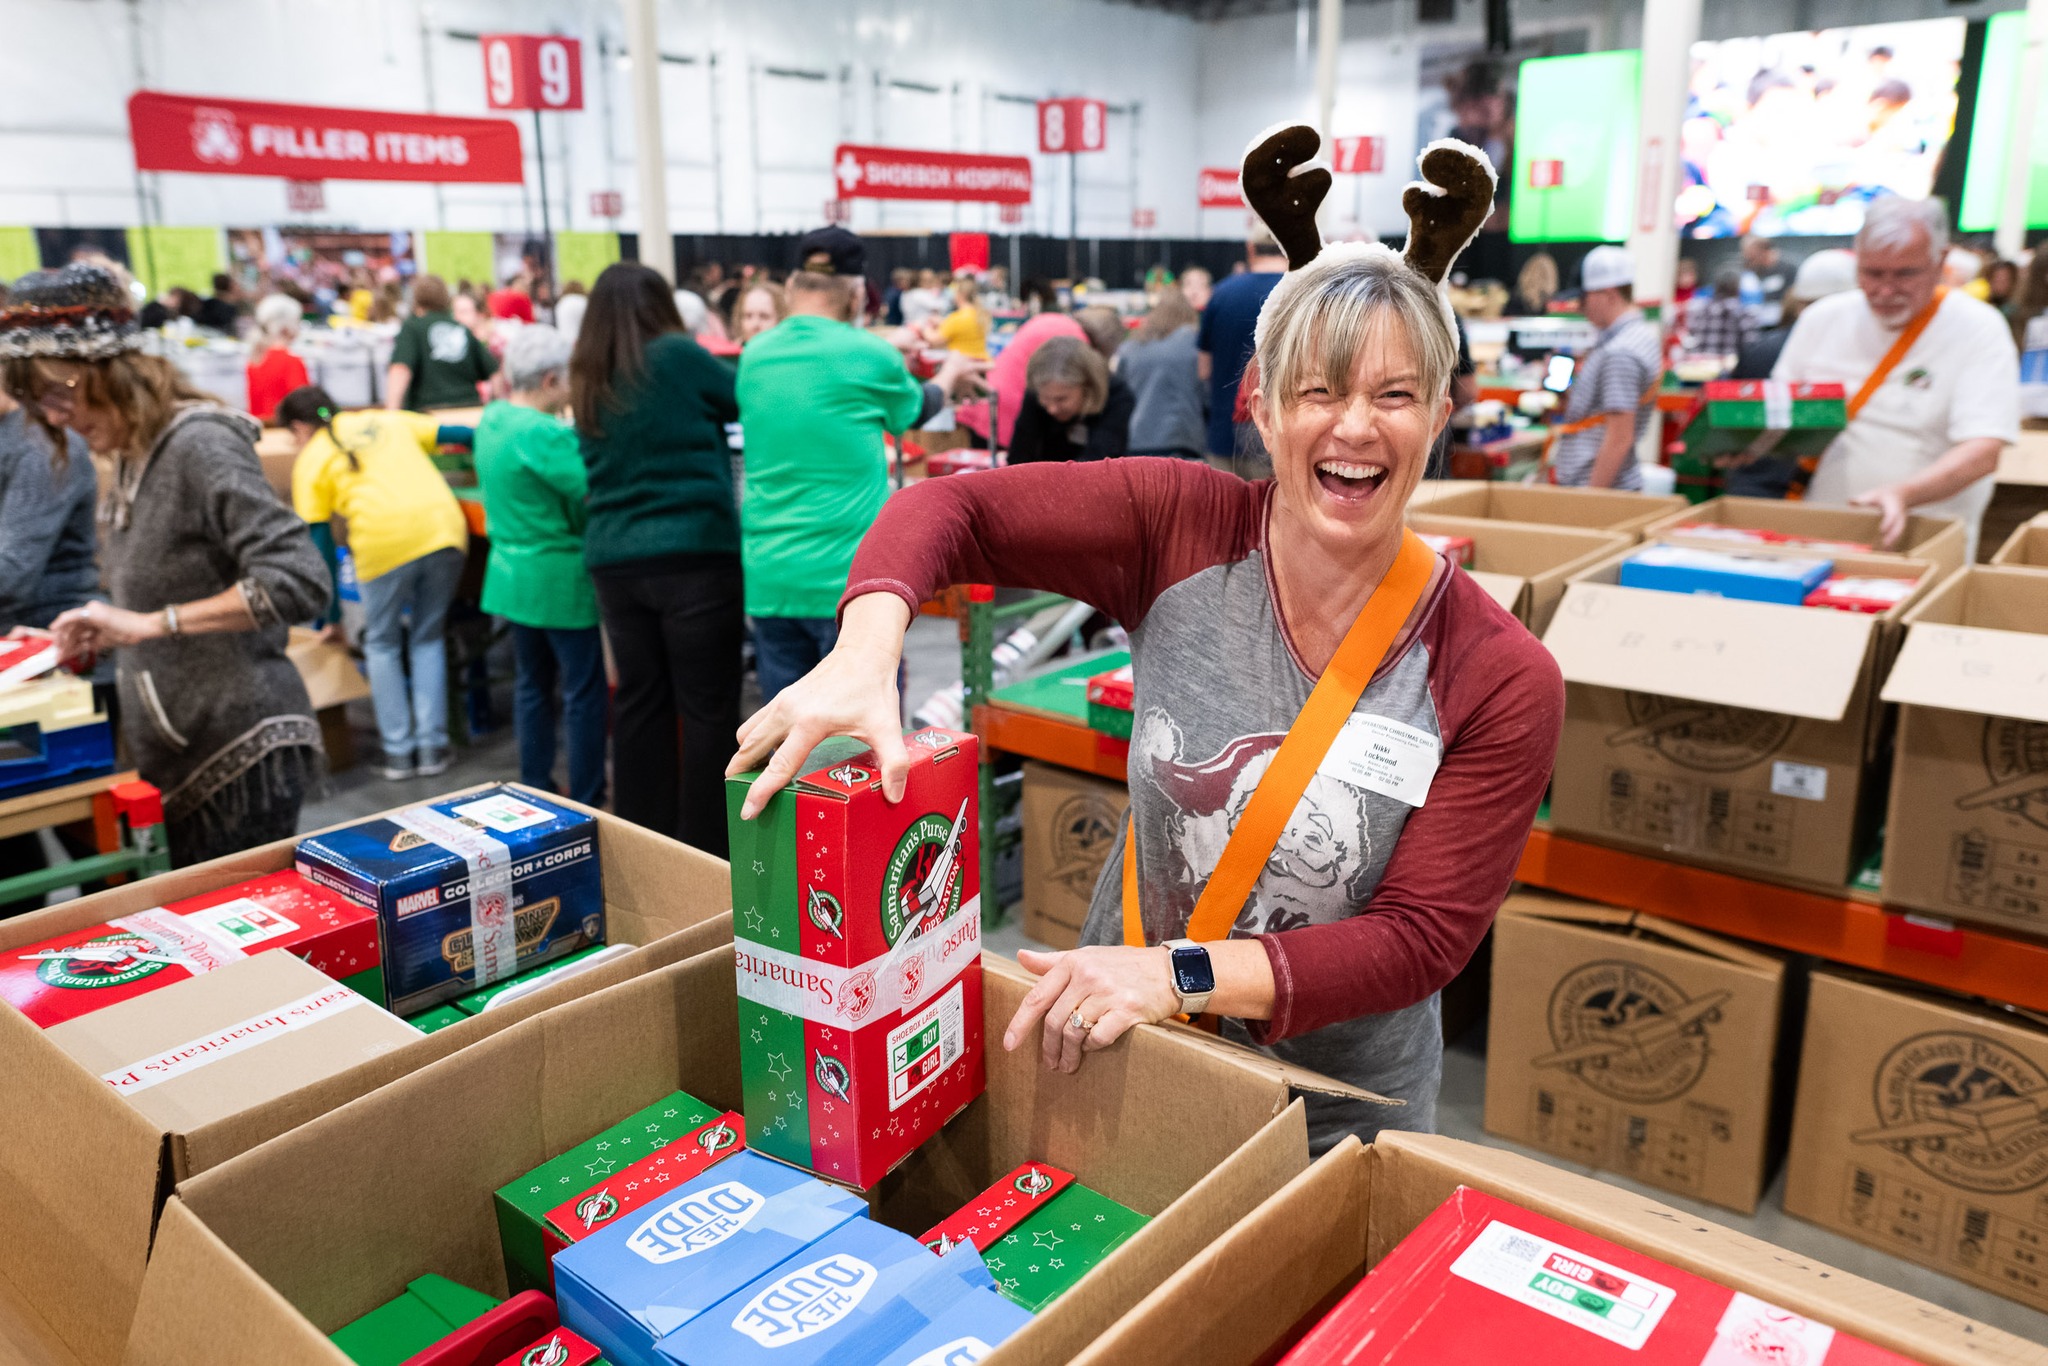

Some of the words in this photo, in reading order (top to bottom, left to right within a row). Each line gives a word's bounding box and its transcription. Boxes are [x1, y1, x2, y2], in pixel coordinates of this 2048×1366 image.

[489, 40, 513, 105] 9
[539, 41, 569, 106] 9
[250, 124, 370, 162] FILLER
[374, 132, 469, 165] ITEMS
[1044, 103, 1065, 149] 8
[1082, 103, 1101, 149] 8
[1372, 743, 1390, 754] Nikki
[1388, 727, 1418, 743] CHRISTMAS
[1419, 736, 1434, 748] CHILD
[1364, 750, 1397, 767] Lockwood
[313, 871, 350, 895] COLLECTOR
[354, 891, 378, 908] CORPS
[444, 861, 534, 900] COLLECTOR
[544, 843, 592, 867] CORPS
[888, 831, 920, 940] Samaritan's
[920, 820, 949, 842] Purse
[397, 887, 440, 916] MARVEL
[924, 861, 960, 934] OPERATION
[948, 886, 960, 918] Child
[943, 915, 977, 957] Purse
[57, 960, 163, 988] Samaritan's
[892, 1019, 921, 1044] SHOEBOX
[922, 1007, 939, 1025] LABEL
[922, 1024, 938, 1049] BOY
[922, 1052, 939, 1075] GIRL
[636, 1187, 754, 1256] DUDE
[681, 1214, 739, 1252] HEY
[1551, 1255, 1594, 1282] GIRL
[742, 1260, 865, 1337] DUDE
[1535, 1276, 1578, 1300] BOY
[791, 1287, 852, 1333] HEY
